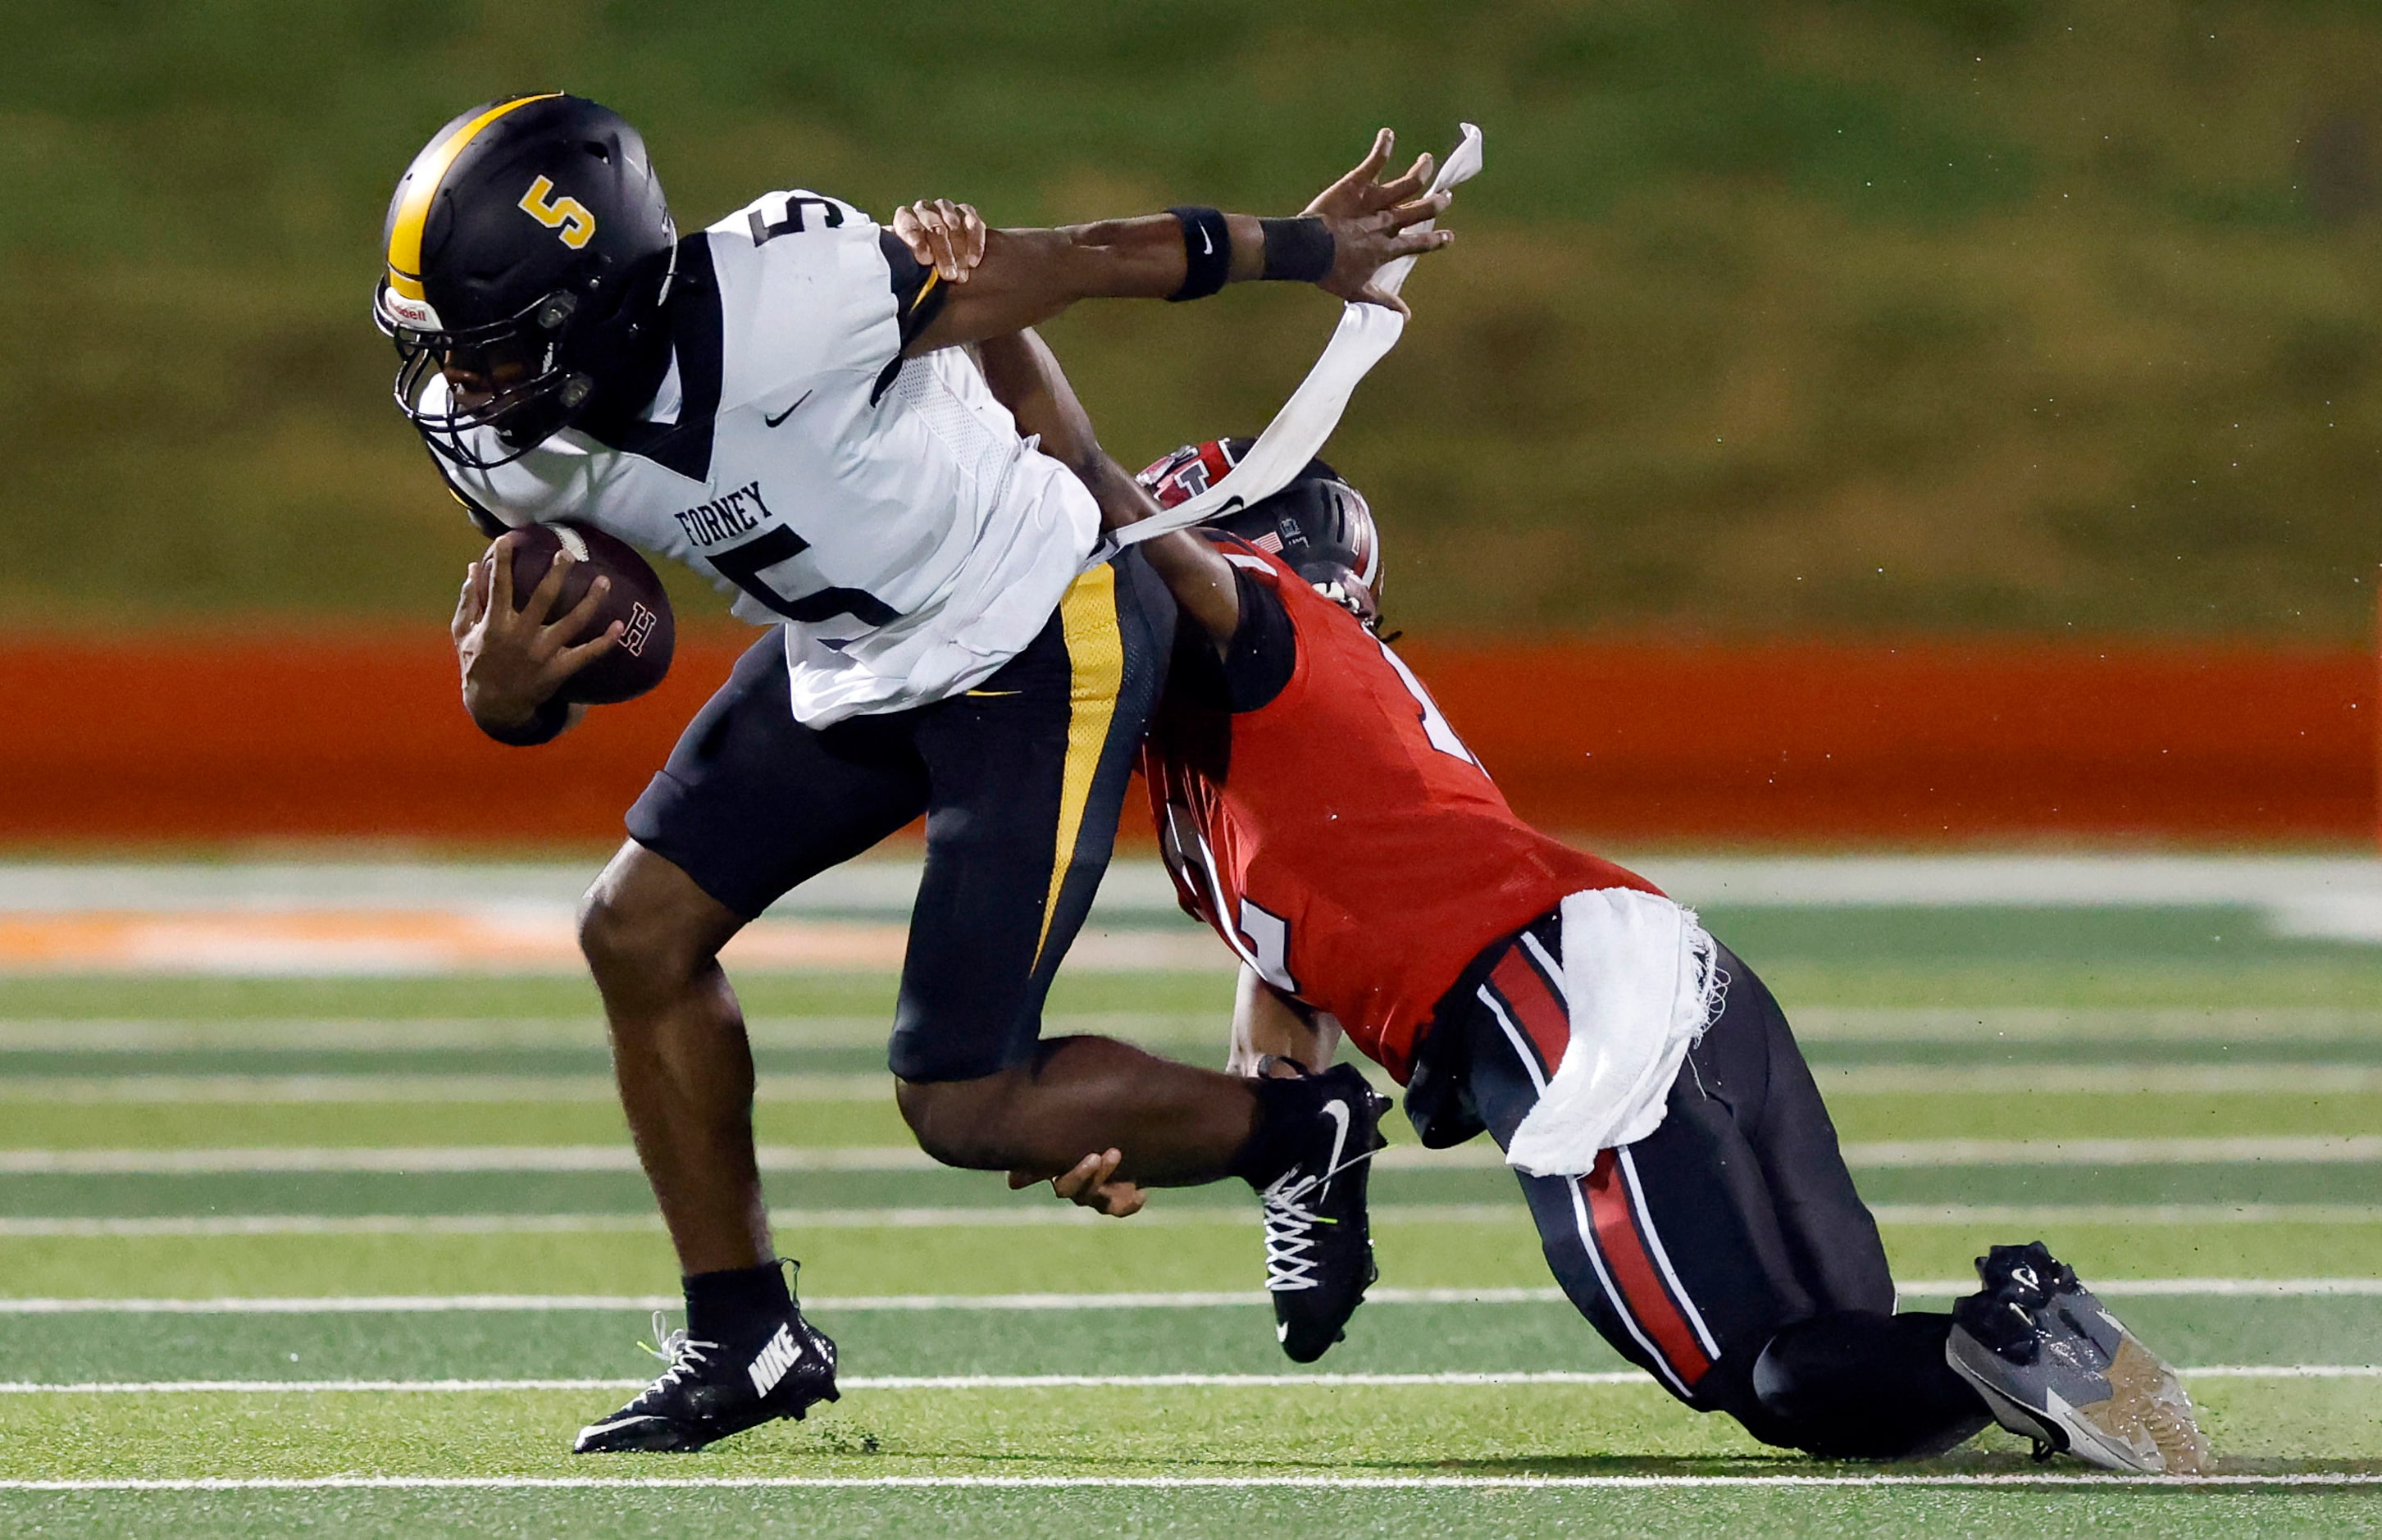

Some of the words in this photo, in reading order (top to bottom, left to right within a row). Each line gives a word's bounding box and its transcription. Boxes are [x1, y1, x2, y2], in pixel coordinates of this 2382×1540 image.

[517, 174, 596, 250] 5
[748, 196, 845, 248] 5
[674, 481, 772, 547] FORNEY
[704, 522, 904, 651] 5
[617, 601, 658, 657] H
[747, 1322, 803, 1400] NIKE
